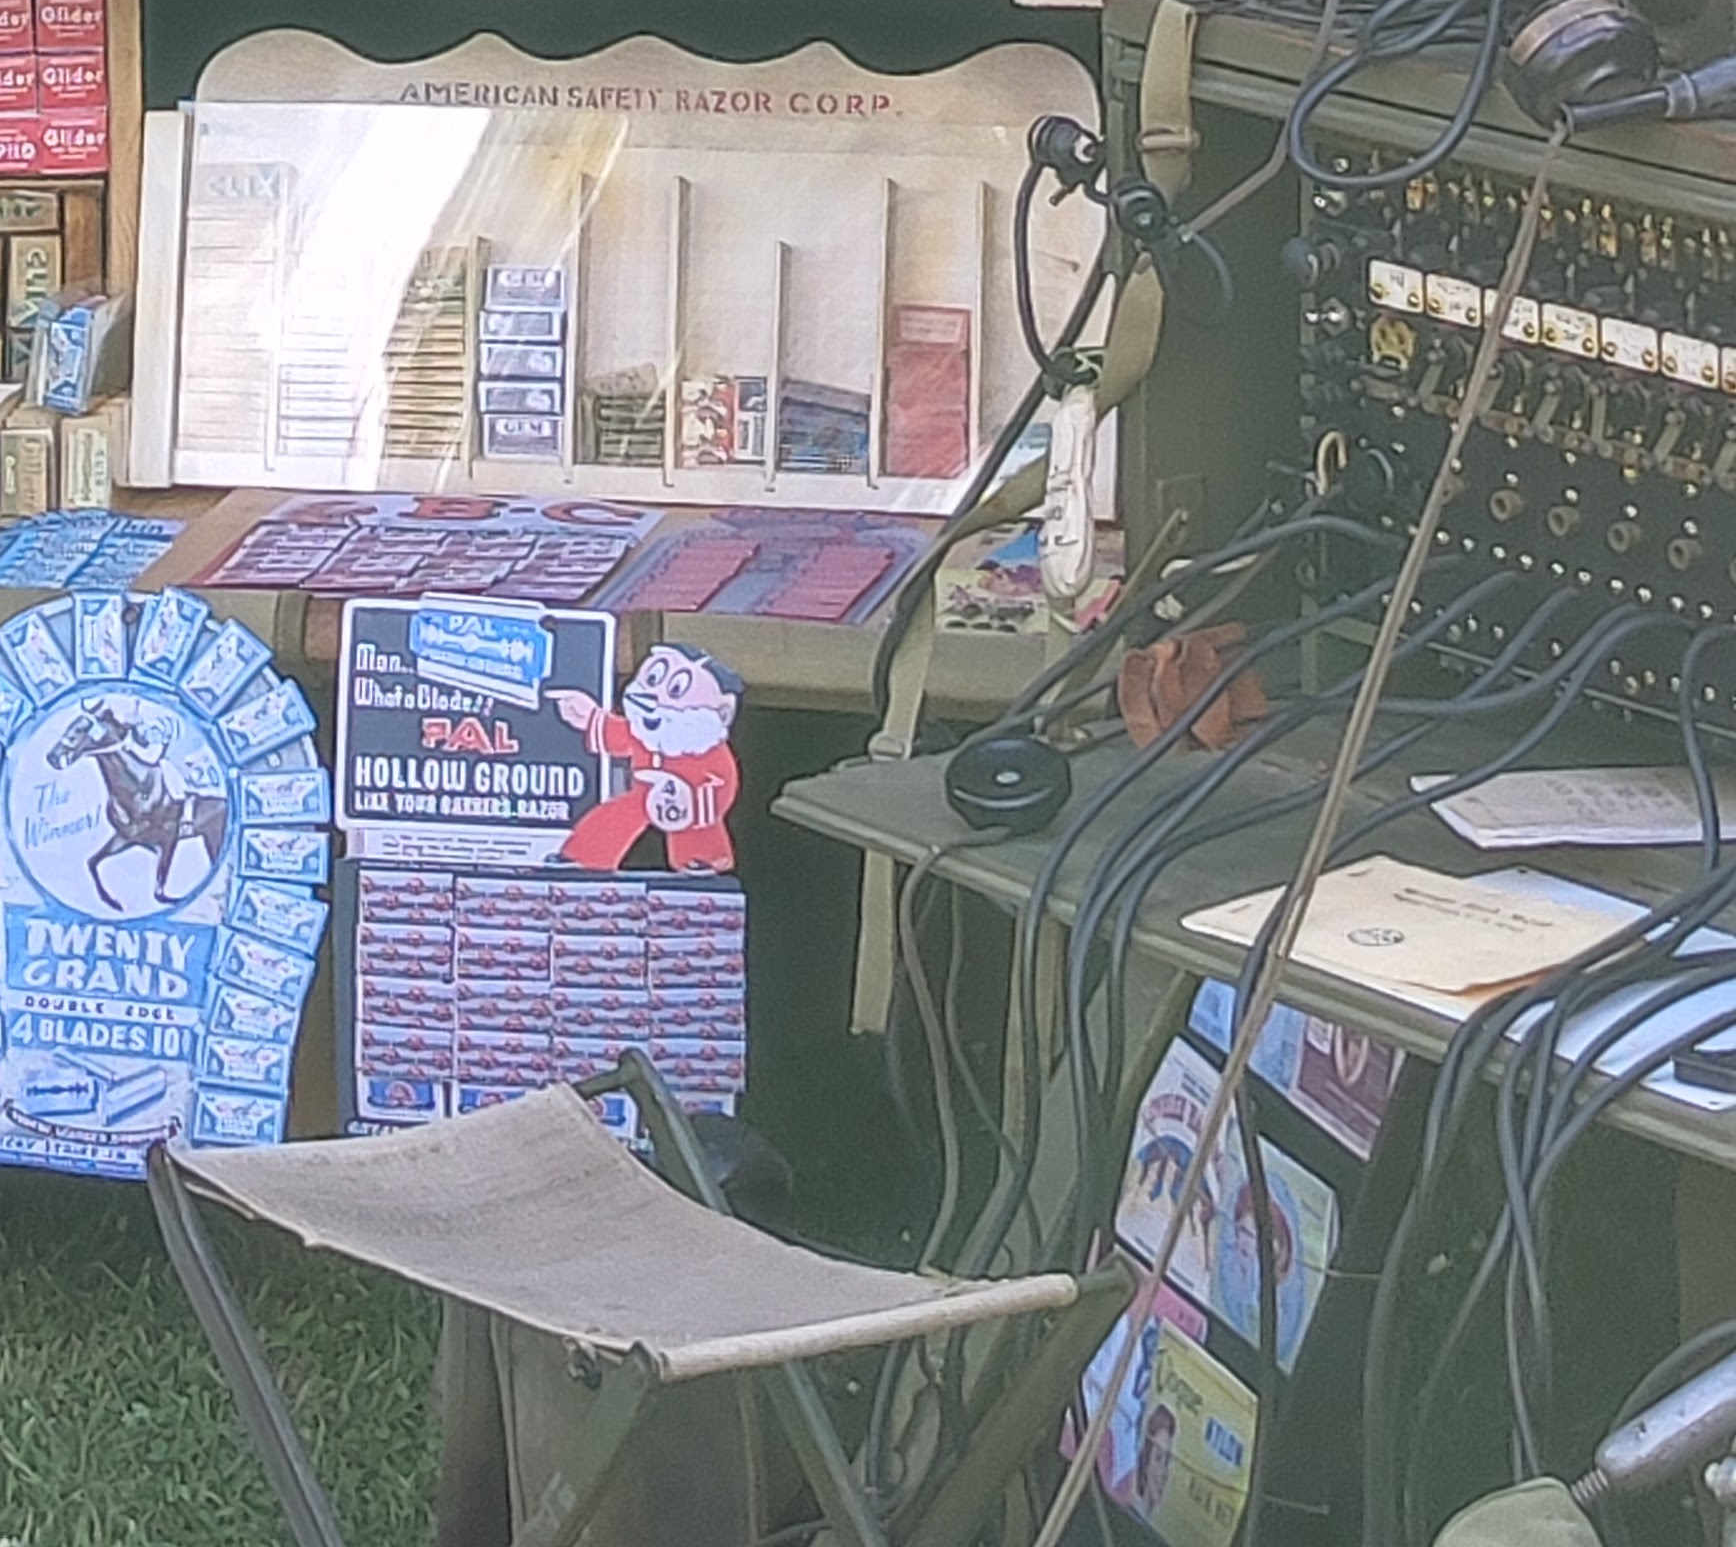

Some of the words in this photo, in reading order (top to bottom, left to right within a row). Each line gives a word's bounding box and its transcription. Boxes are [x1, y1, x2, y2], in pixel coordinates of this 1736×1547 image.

[42, 7, 102, 26] Glider
[42, 66, 102, 85] Glider
[399, 82, 559, 107] AMERICAN
[674, 89, 772, 114] RAZOR
[789, 91, 906, 118] CORP.
[44, 128, 106, 147] Glider
[448, 615, 497, 637] PAL
[421, 717, 520, 755] PAL
[355, 755, 467, 791] HOLLOW
[473, 761, 585, 798] GROUND
[517, 798, 570, 821] RAZOR
[25, 918, 196, 972] TWENTY
[23, 958, 189, 999] GRAND
[24, 995, 105, 1015] DOUBLE
[124, 1003, 175, 1021] EDGE
[12, 1013, 33, 1044] 4
[38, 1018, 147, 1052] BLADES
